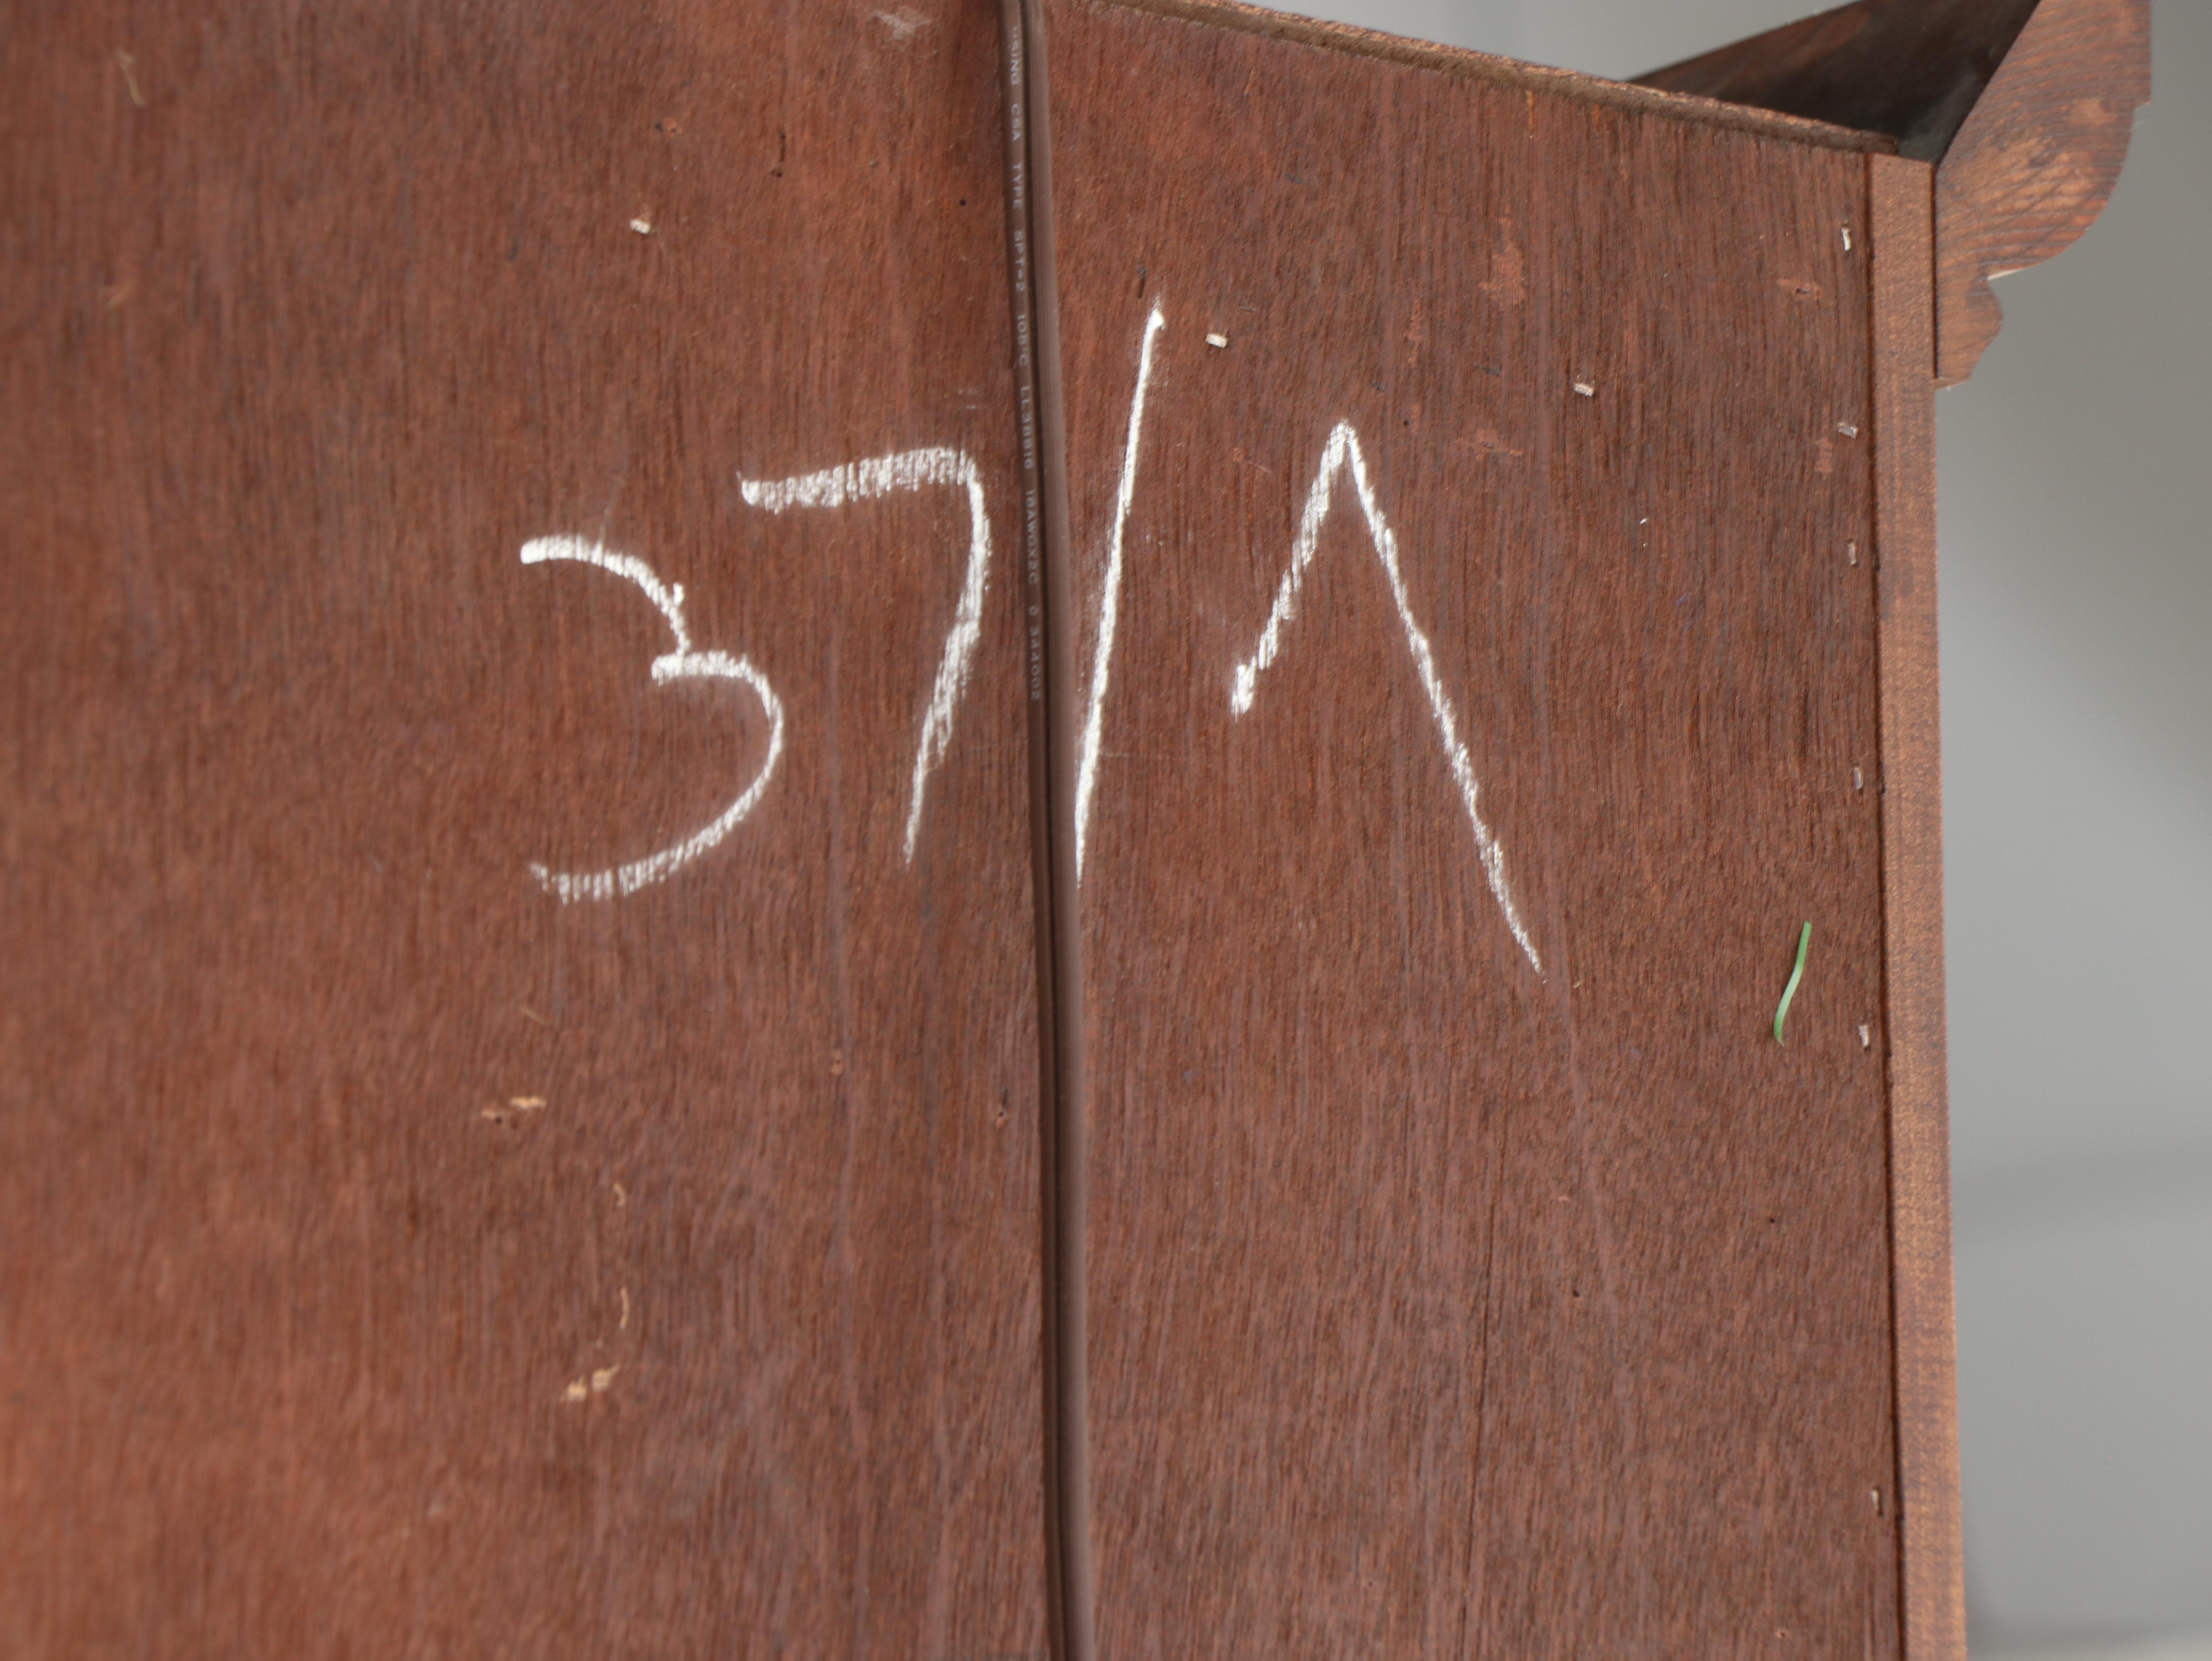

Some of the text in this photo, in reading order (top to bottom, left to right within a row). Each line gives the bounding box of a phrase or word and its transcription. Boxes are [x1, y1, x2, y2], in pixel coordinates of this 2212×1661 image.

[1011, 103, 1021, 141] CSA
[1013, 161, 1023, 209] TYPE
[1014, 230, 1025, 292] SPT-2
